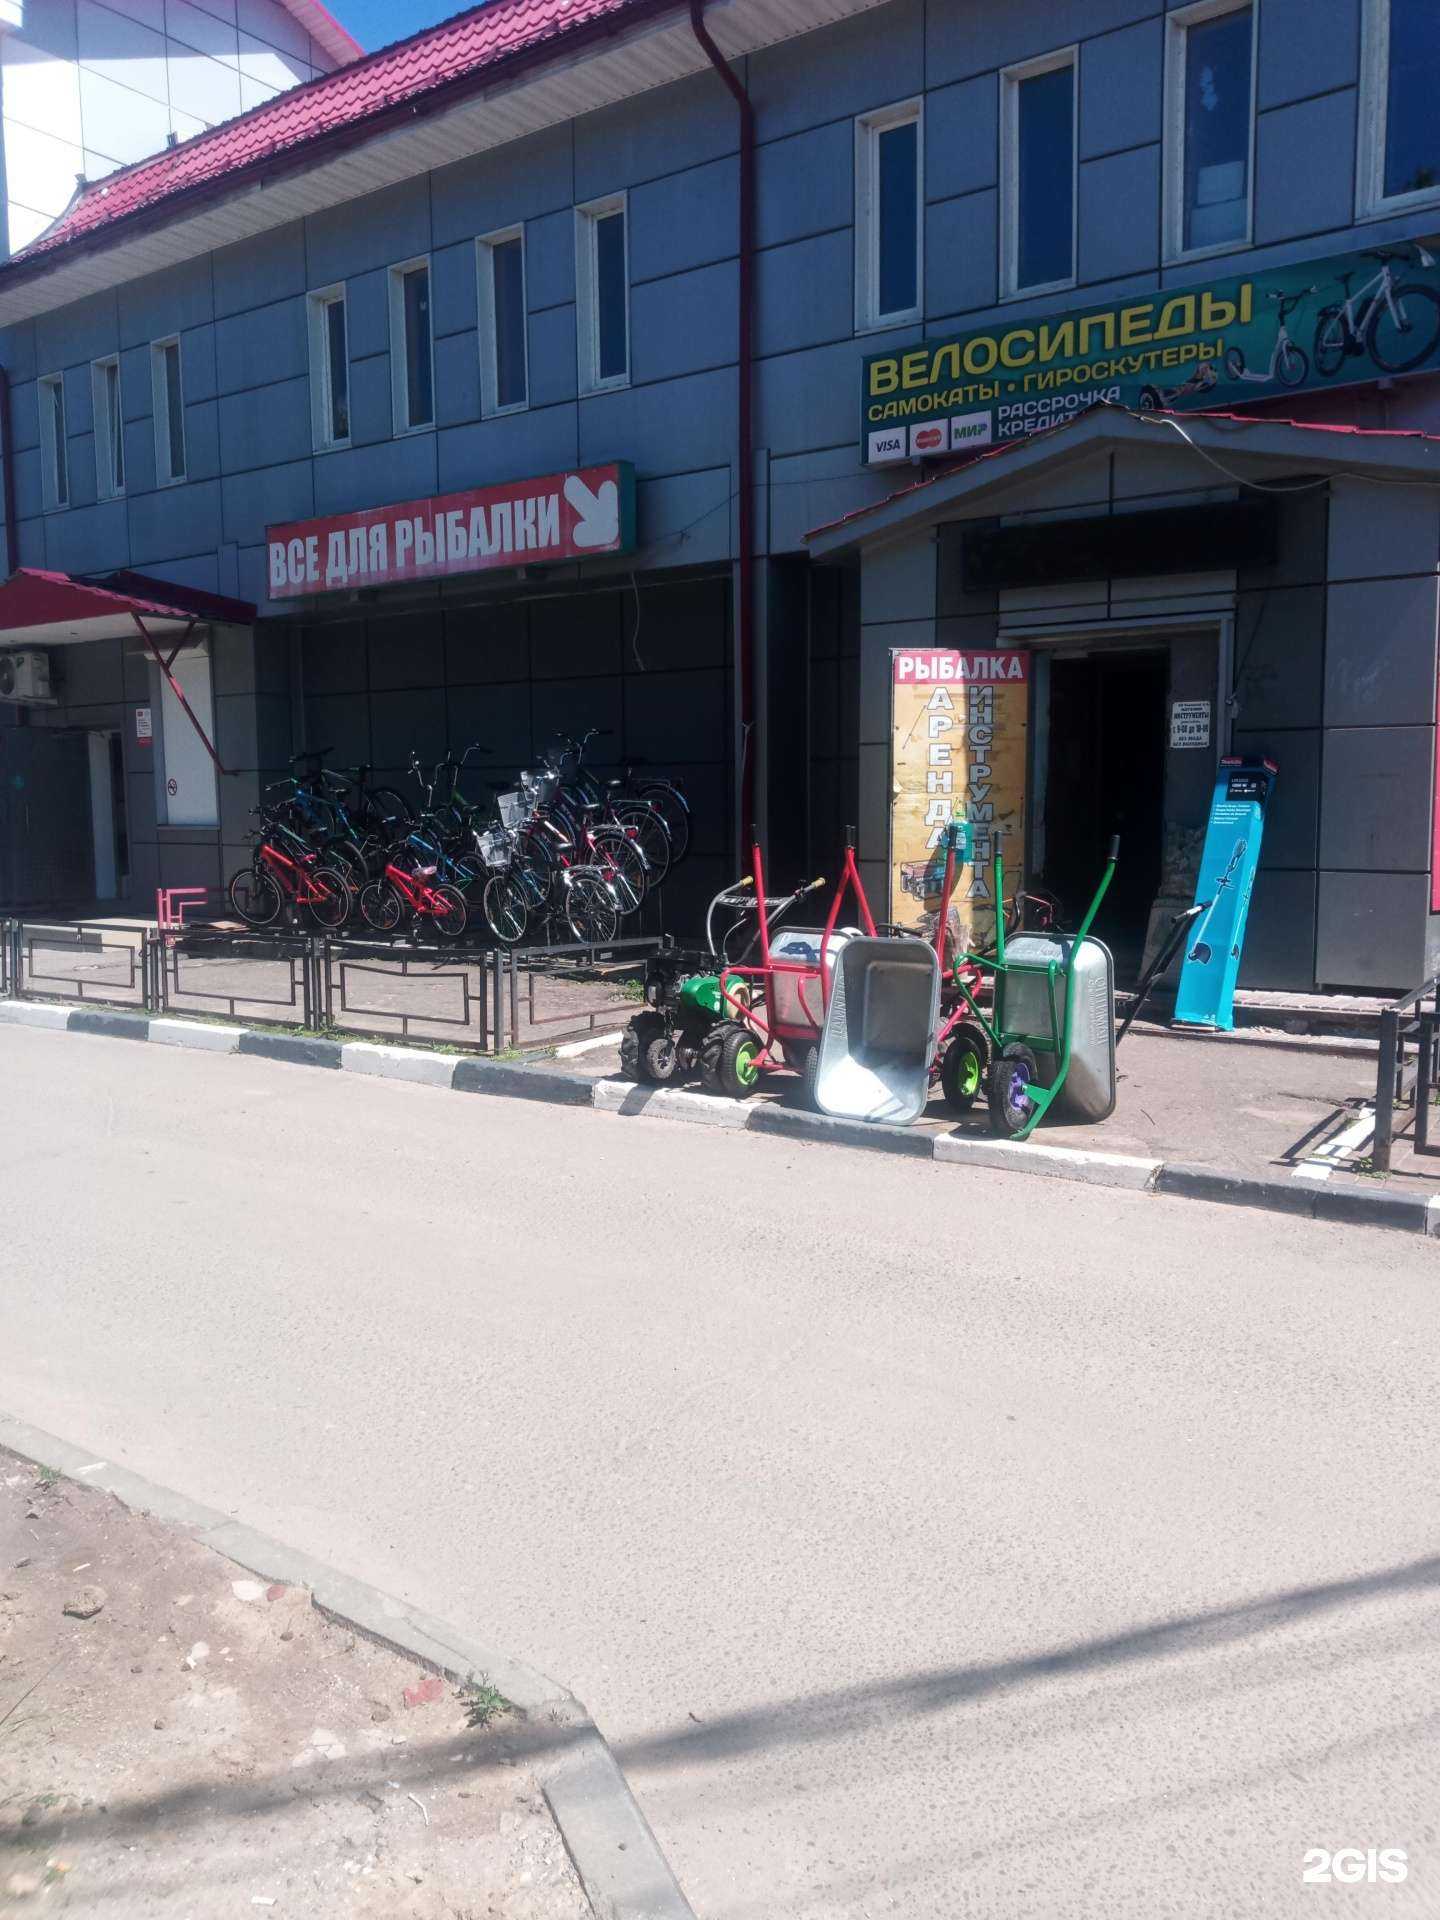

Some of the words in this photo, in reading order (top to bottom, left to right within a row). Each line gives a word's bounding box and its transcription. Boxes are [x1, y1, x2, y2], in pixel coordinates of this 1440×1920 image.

[868, 282, 1254, 397] ВЕЛОСИПЕДЫ
[868, 380, 1000, 421] САМОКАТЫ
[1023, 338, 1224, 392] ГИРОСКУТЕРЫ
[997, 385, 1121, 421] РАССРОЧКА
[876, 438, 901, 453] VISA
[954, 422, 988, 439] МИР
[997, 409, 1079, 437] КРЕДИТ
[269, 535, 321, 587] ВСЕ
[325, 522, 388, 588] ДЛЯ
[395, 493, 560, 569] РЫБАЛКИ
[898, 655, 1024, 680] РЫБАЛКА
[924, 686, 955, 850] АРЕНДА
[966, 685, 995, 898] ИНСТРУМЕНТА
